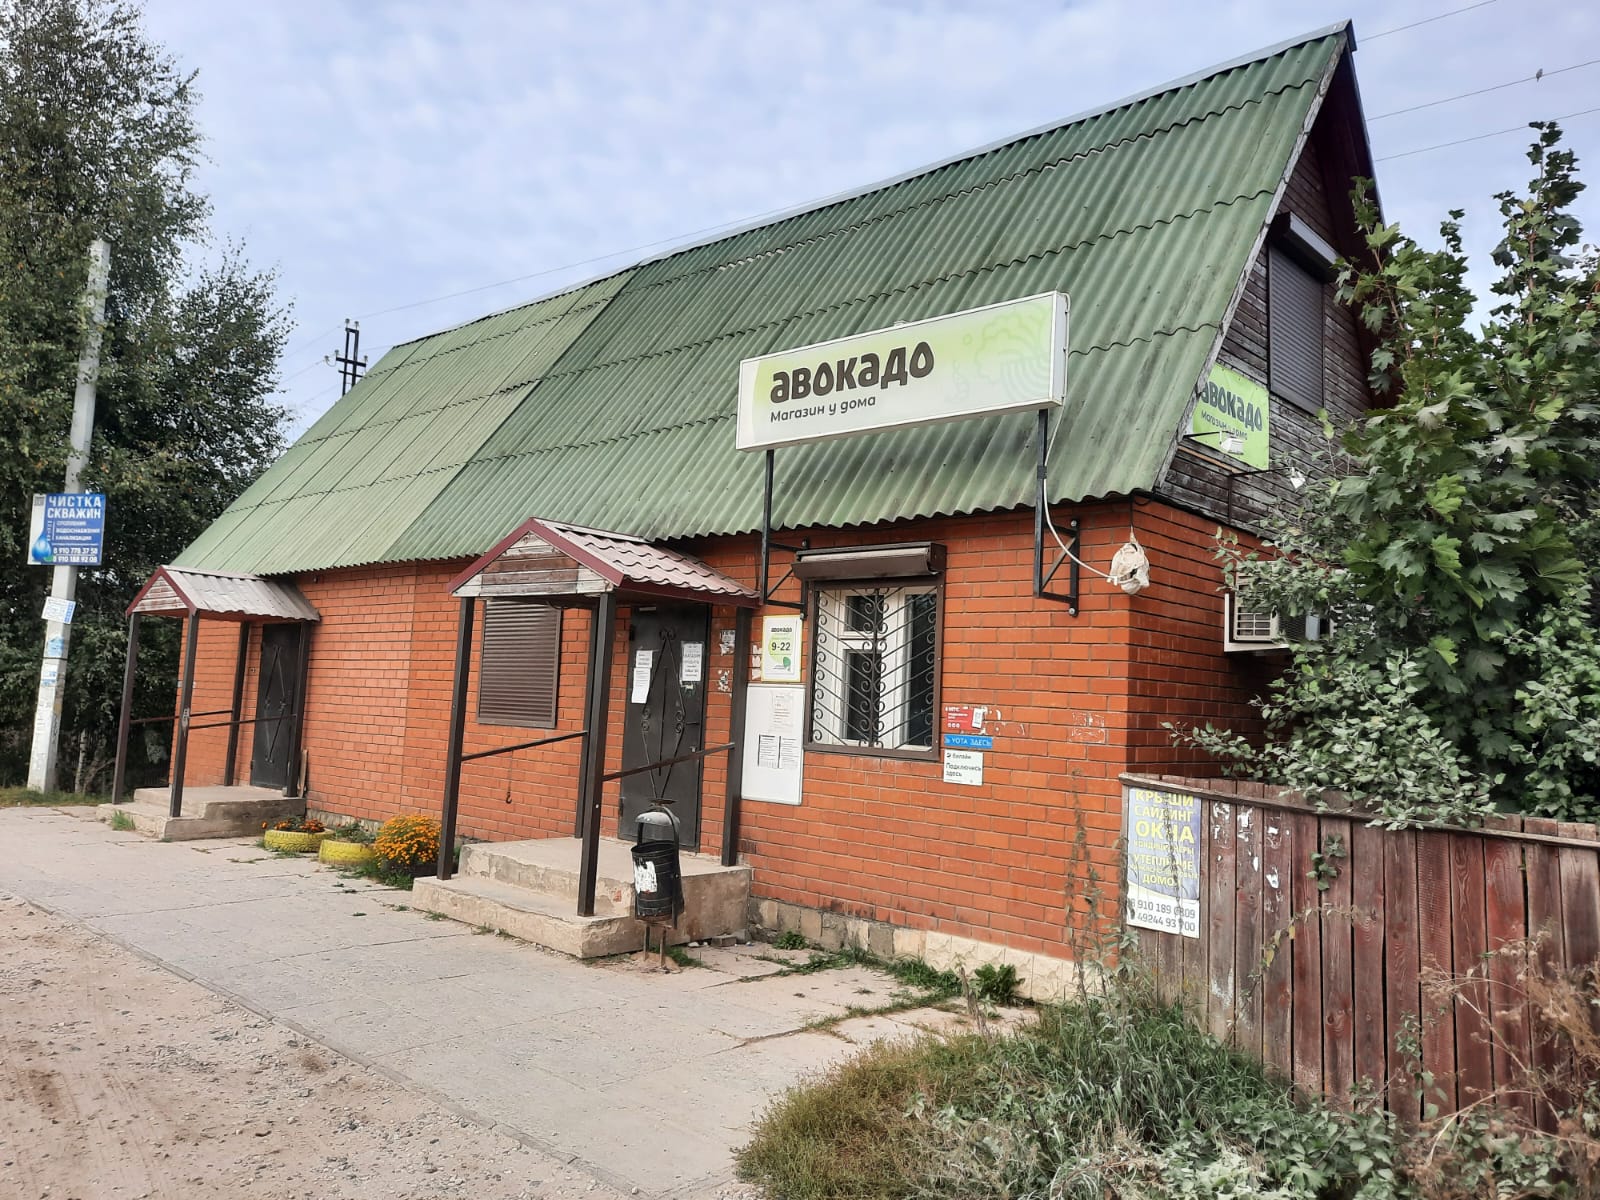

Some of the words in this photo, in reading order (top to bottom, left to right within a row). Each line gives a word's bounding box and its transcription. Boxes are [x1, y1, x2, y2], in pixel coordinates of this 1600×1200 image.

[770, 342, 935, 404] авокадо
[770, 402, 825, 422] Магазин
[828, 400, 837, 416] у
[840, 395, 876, 414] дома
[49, 496, 102, 508] ЧИСТКА
[47, 507, 102, 520] СКВАЖИН
[771, 642, 792, 651] 9-22
[951, 737, 968, 745] YOTA
[1137, 899, 1154, 911] 910
[1155, 903, 1172, 915] 189
[1137, 912, 1164, 926] 49244
[1165, 918, 1177, 928] 93
